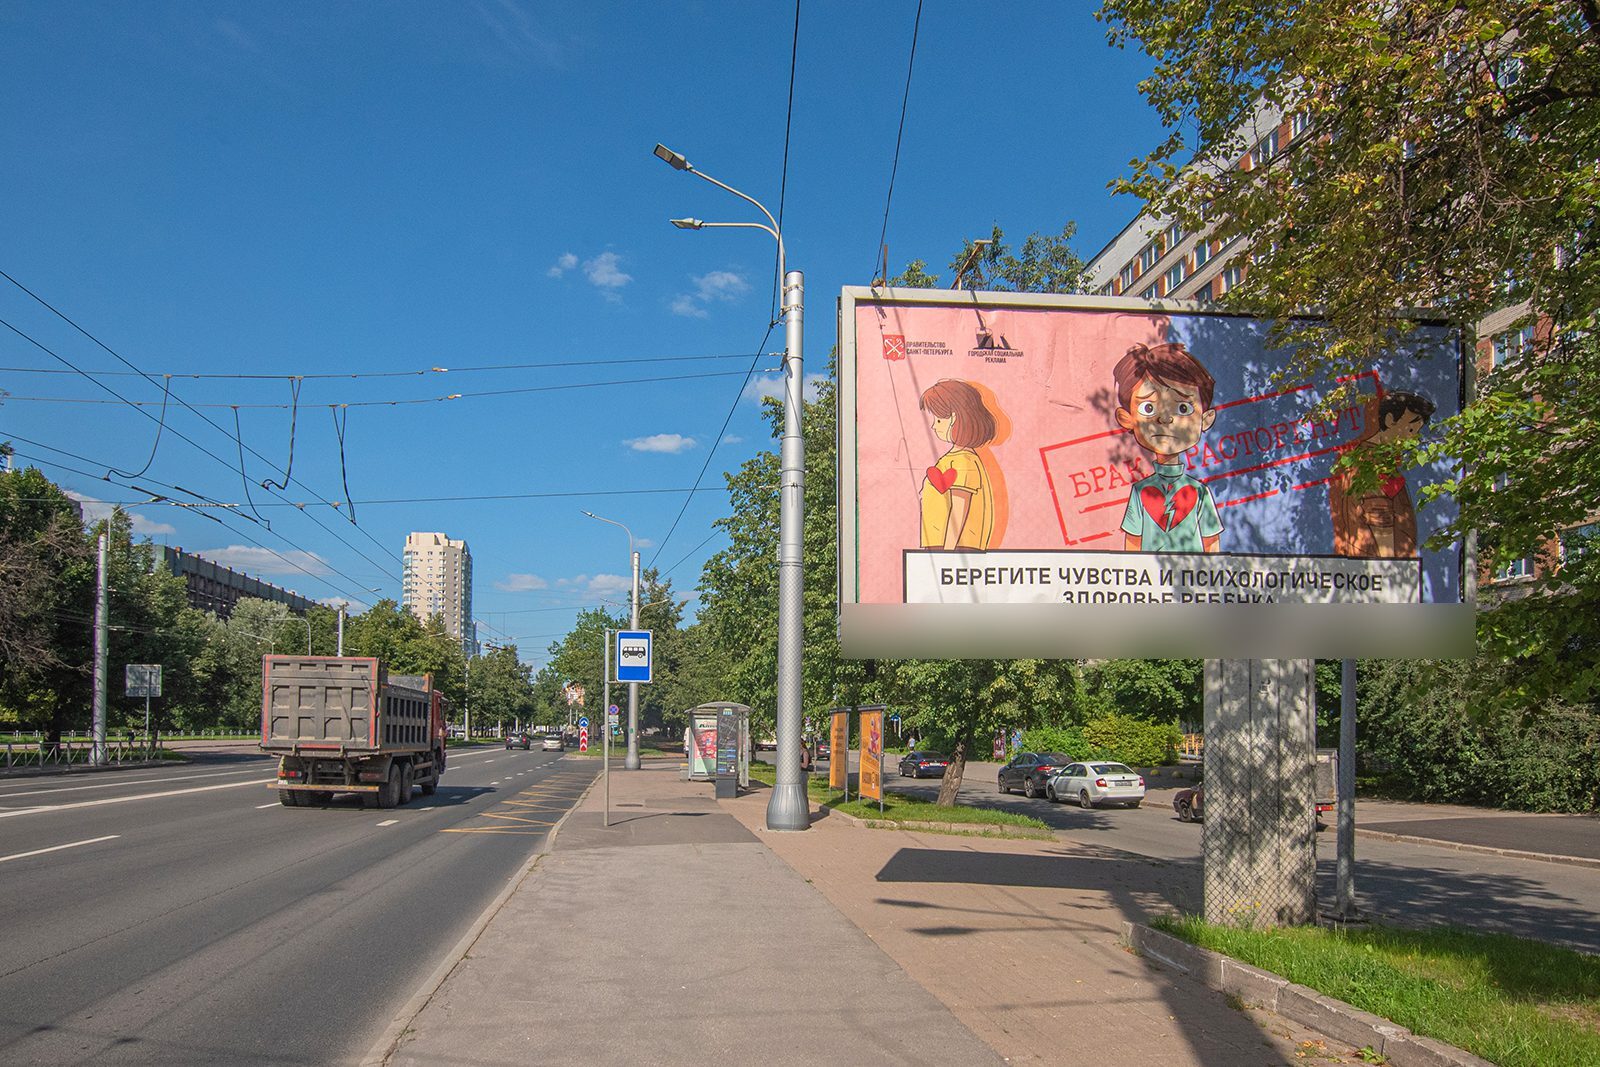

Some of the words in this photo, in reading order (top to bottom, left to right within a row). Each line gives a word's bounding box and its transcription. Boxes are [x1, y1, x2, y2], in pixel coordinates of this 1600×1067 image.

[906, 348, 954, 356] САНКТ-ПЕТЕРБУРГА
[1068, 457, 1149, 498] БРАК
[941, 567, 1051, 586] БЕРЕГИТЕ
[1058, 567, 1152, 586] ЧУВСТВА
[1160, 569, 1173, 586] И
[1181, 569, 1383, 591] ПСИХОЛОГИЧЕСКОЕ
